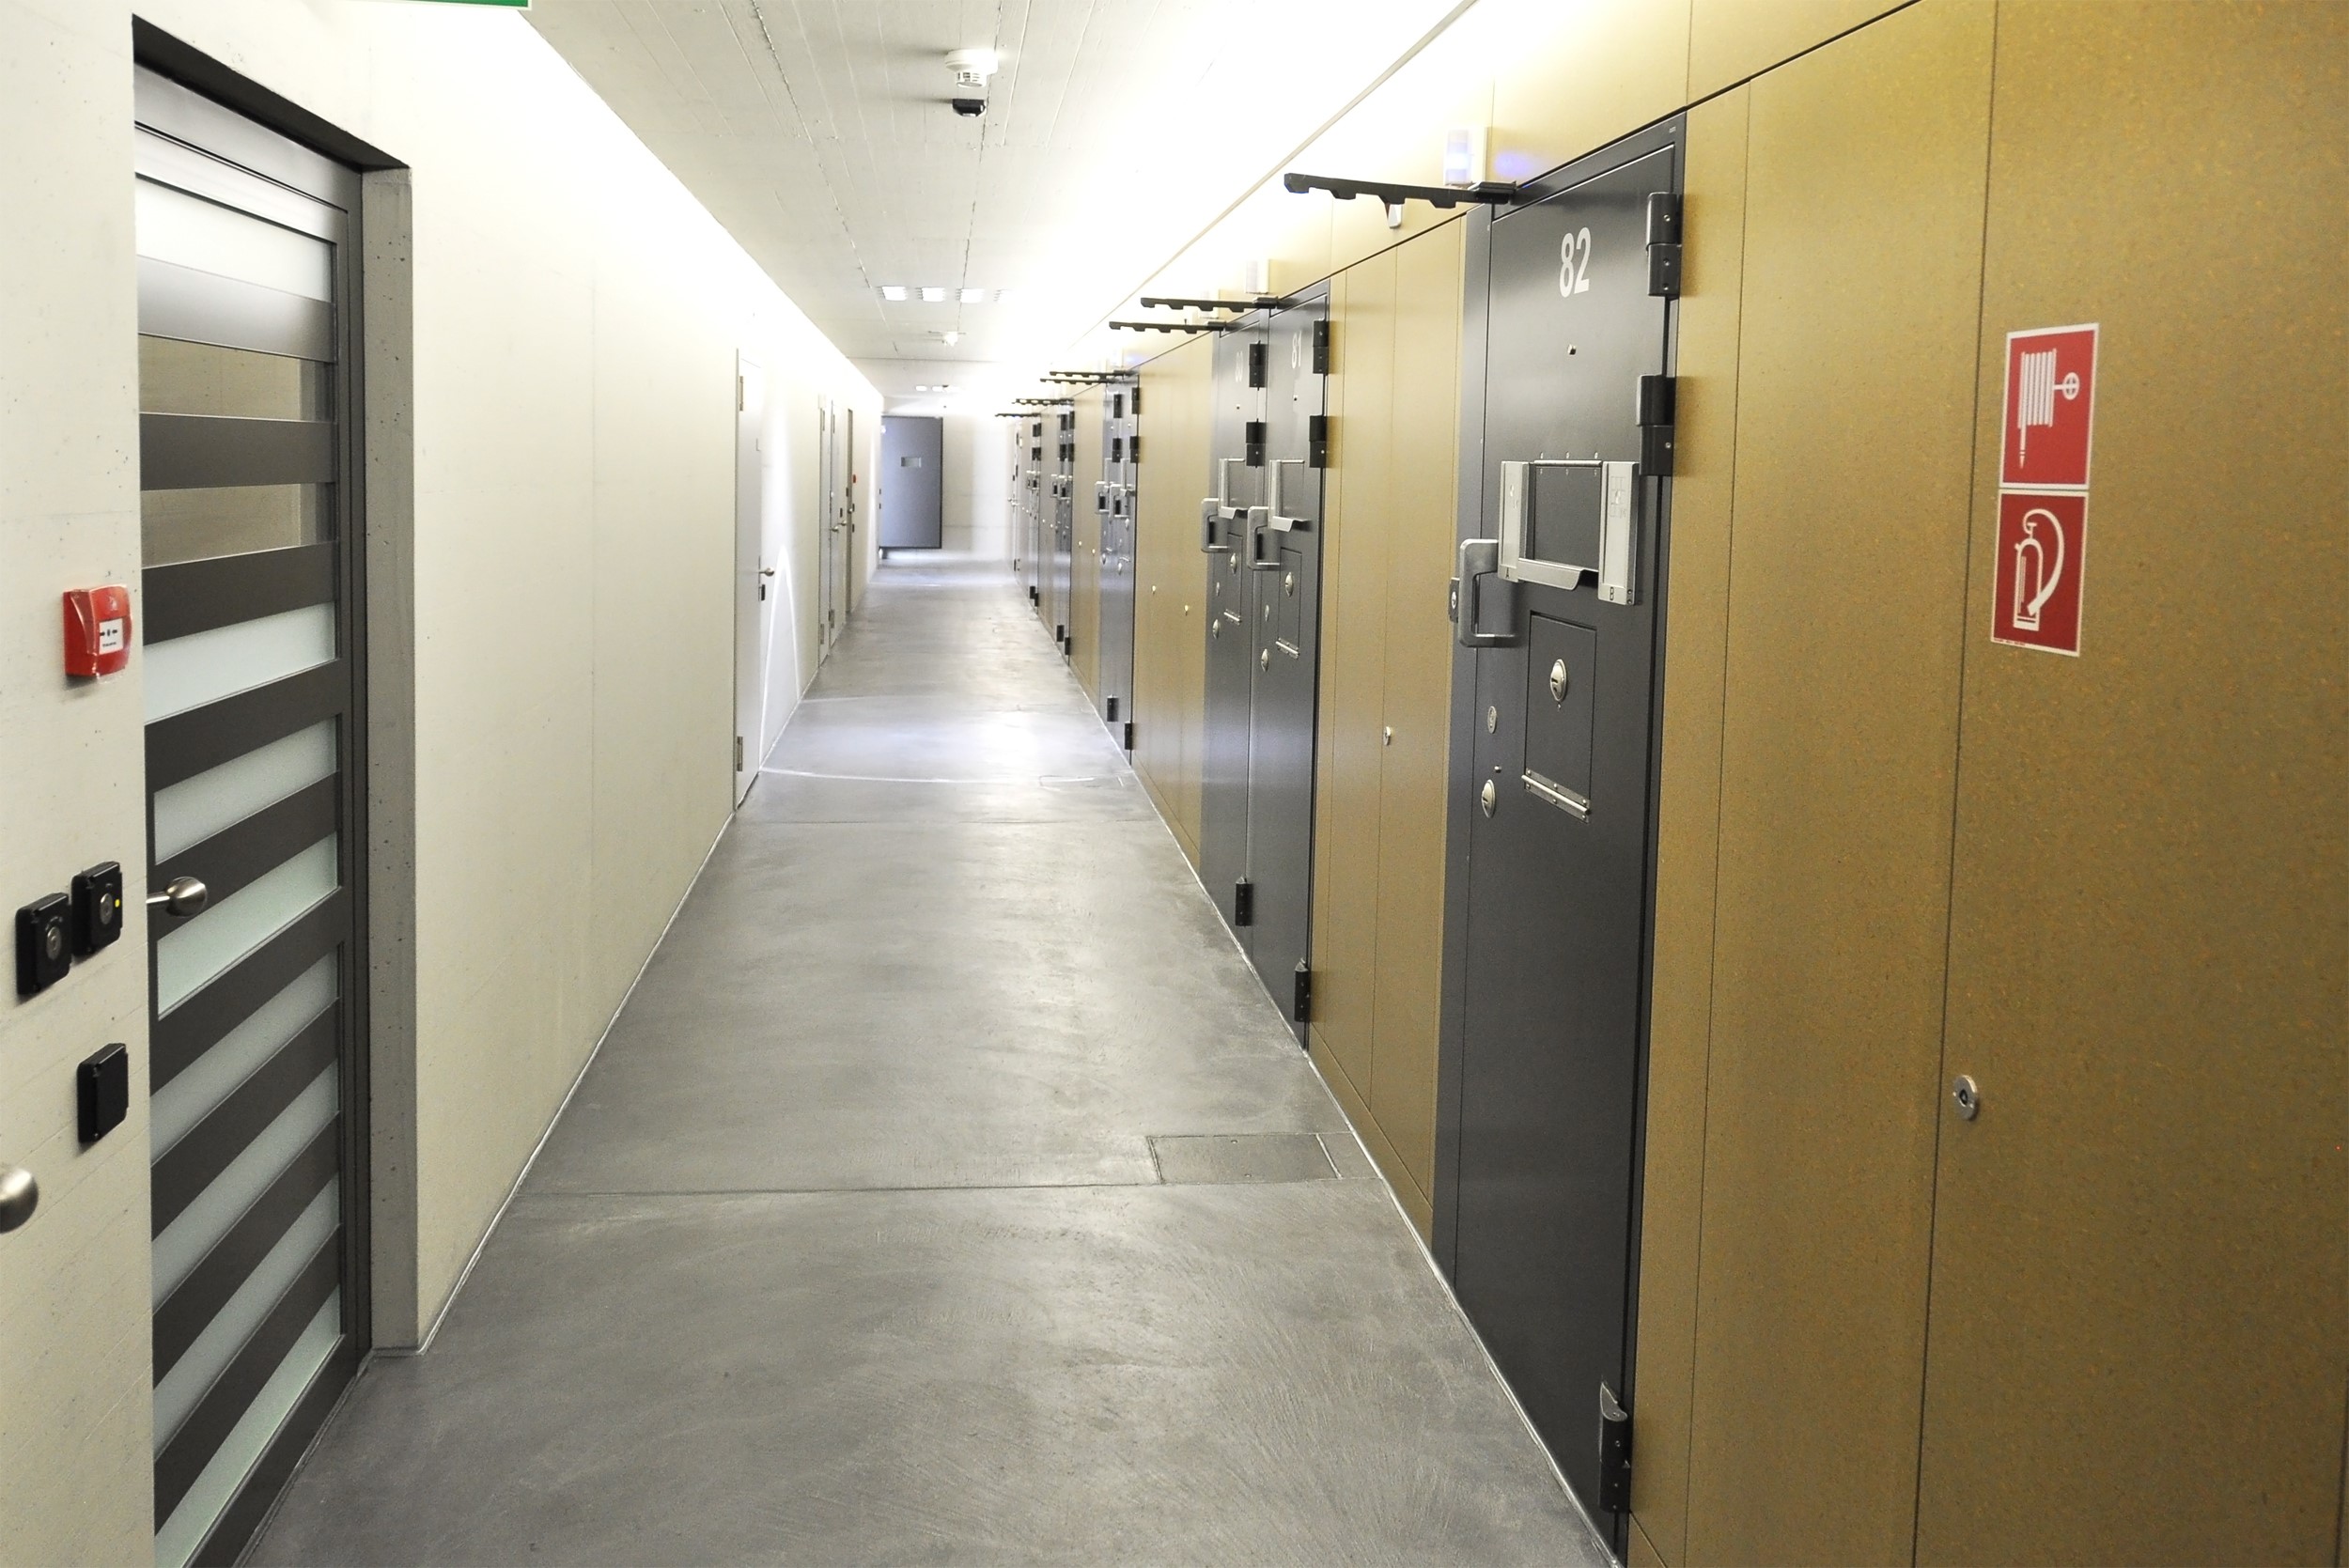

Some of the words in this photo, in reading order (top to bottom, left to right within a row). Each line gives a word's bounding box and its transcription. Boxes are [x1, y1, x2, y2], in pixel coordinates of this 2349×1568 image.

[1560, 227, 1591, 298] 82
[1291, 330, 1302, 369] 81
[1505, 567, 1510, 580] A
[1610, 586, 1615, 601] B
